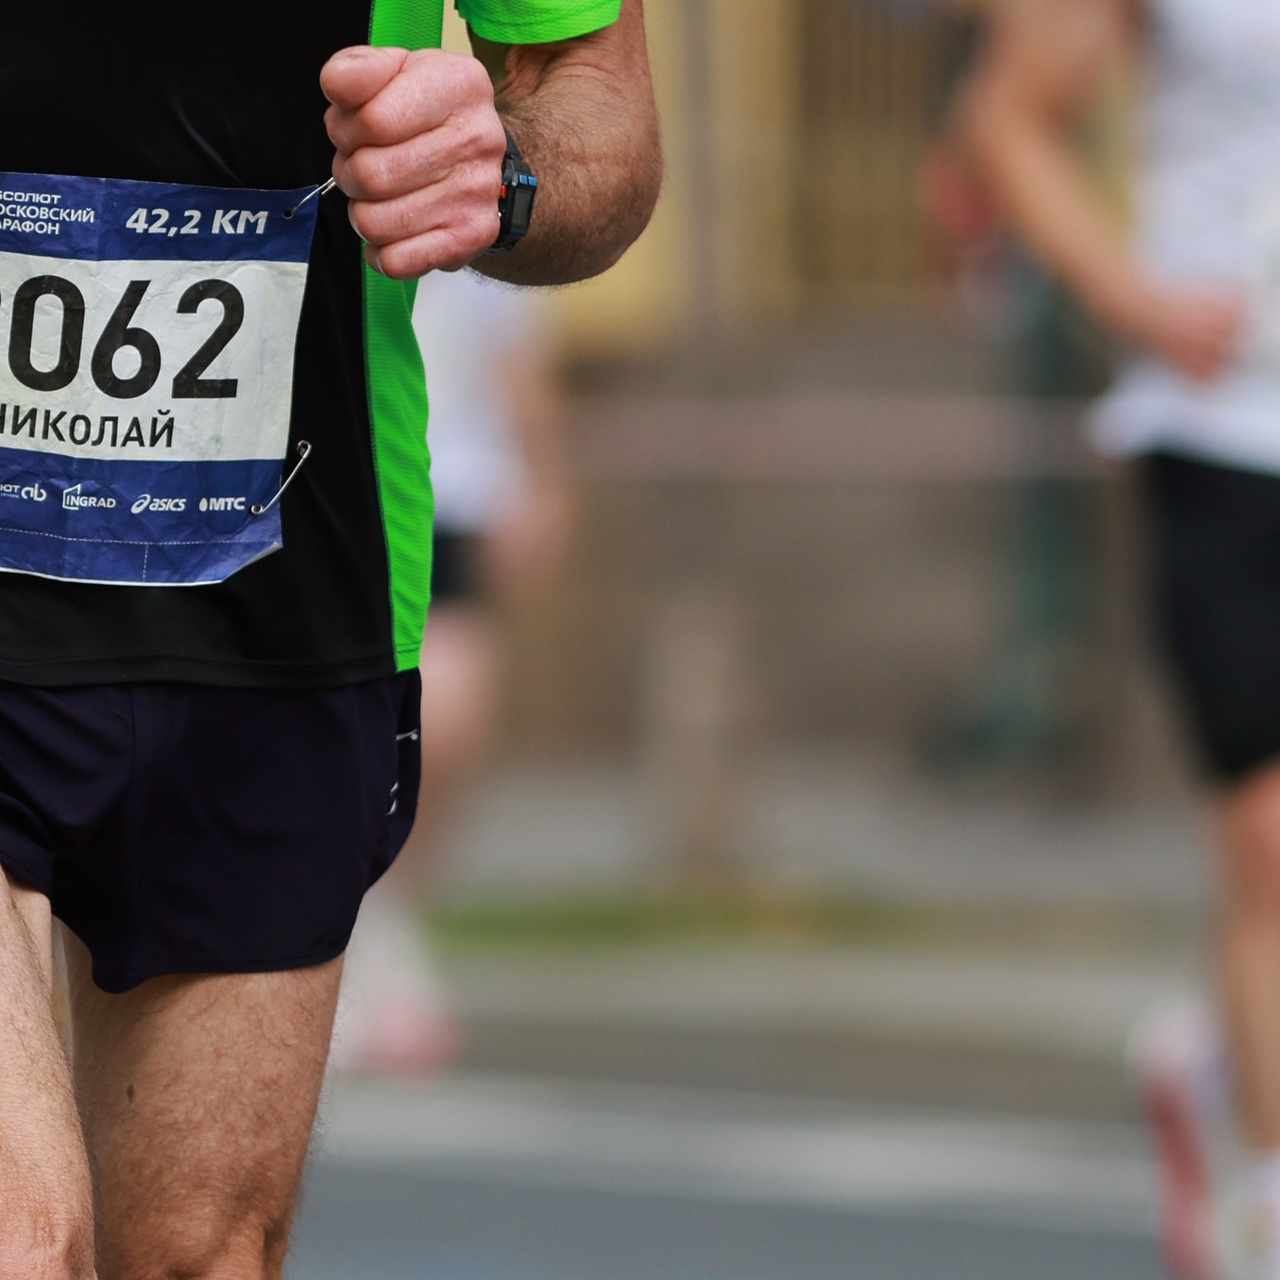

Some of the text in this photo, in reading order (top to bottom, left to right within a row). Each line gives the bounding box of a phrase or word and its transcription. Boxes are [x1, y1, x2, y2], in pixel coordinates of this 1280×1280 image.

[125, 207, 269, 237] 42,2 КМ
[65, 494, 116, 508] INGRAD
[208, 497, 246, 511] МТС
